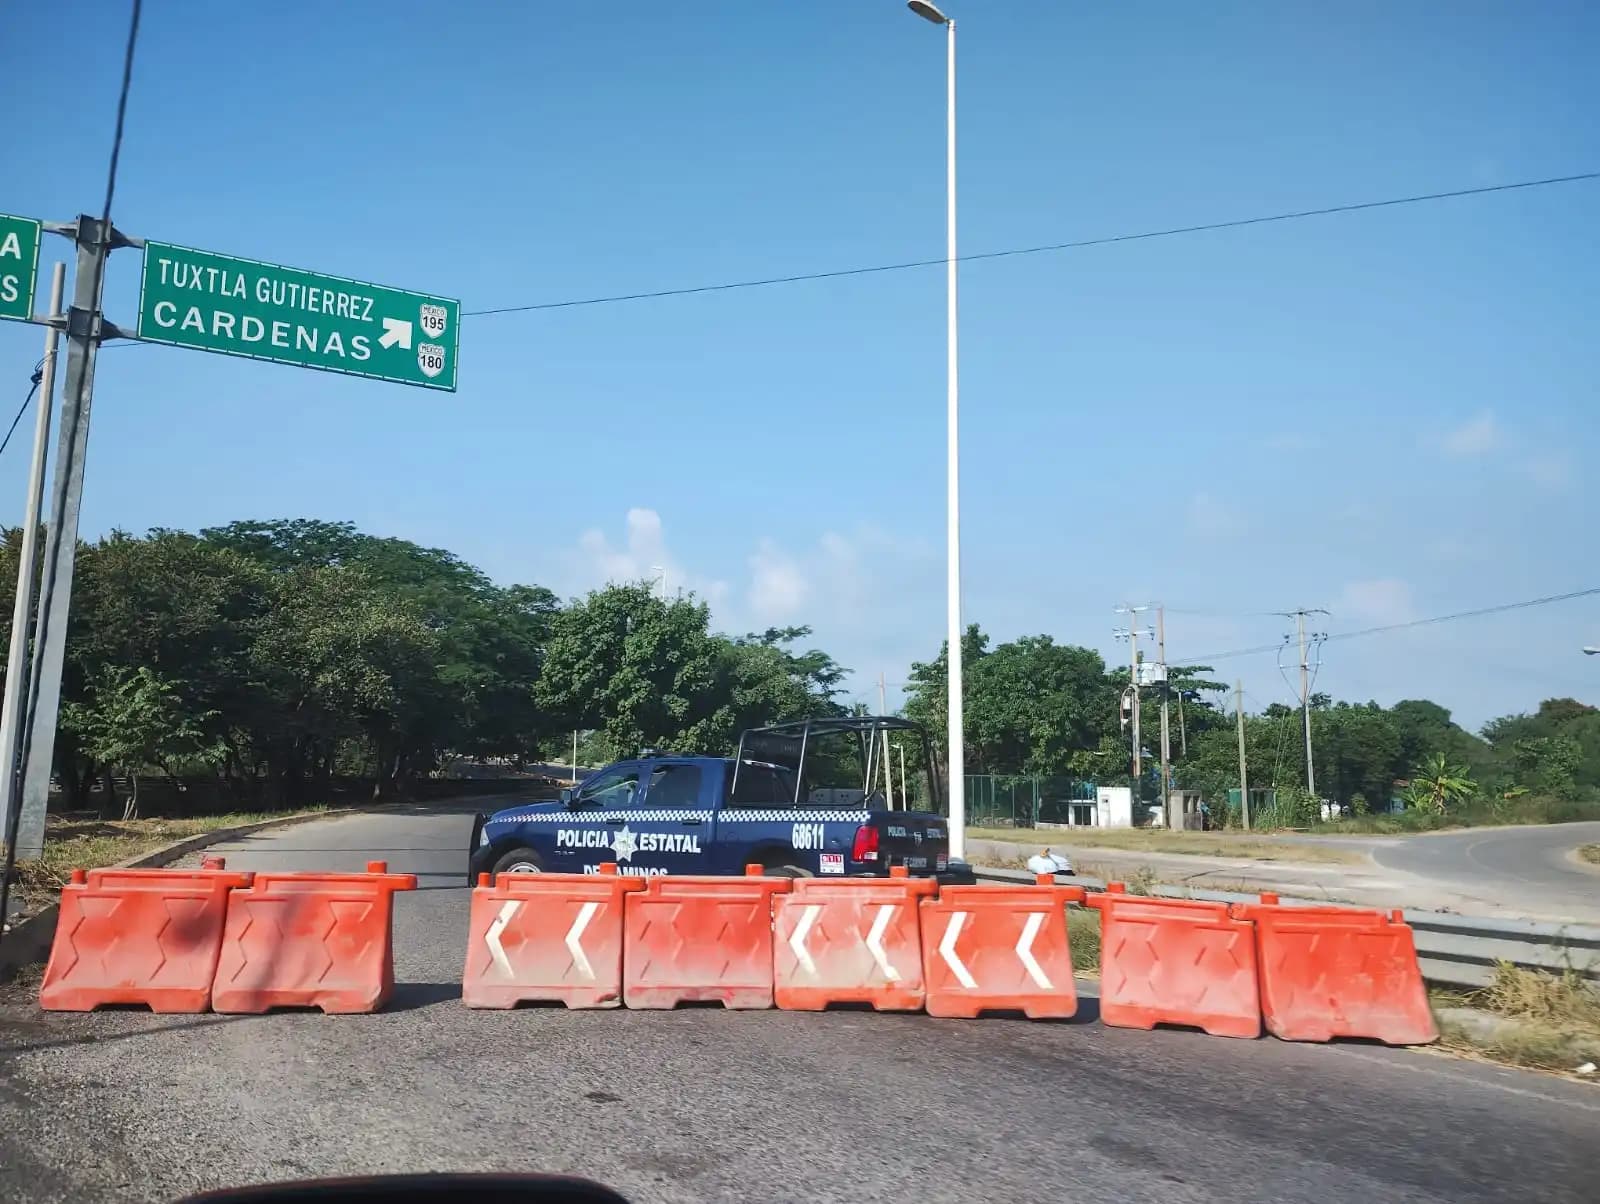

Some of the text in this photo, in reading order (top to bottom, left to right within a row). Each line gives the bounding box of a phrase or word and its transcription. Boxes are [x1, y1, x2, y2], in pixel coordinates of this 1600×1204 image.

[158, 258, 375, 322] TUXTLA GUTIERREZ
[153, 301, 371, 361] CARDENAS
[423, 315, 444, 330] 195
[420, 354, 442, 369] 180
[556, 829, 701, 853] POLICIA ESTATAL
[792, 822, 824, 850] 68611
